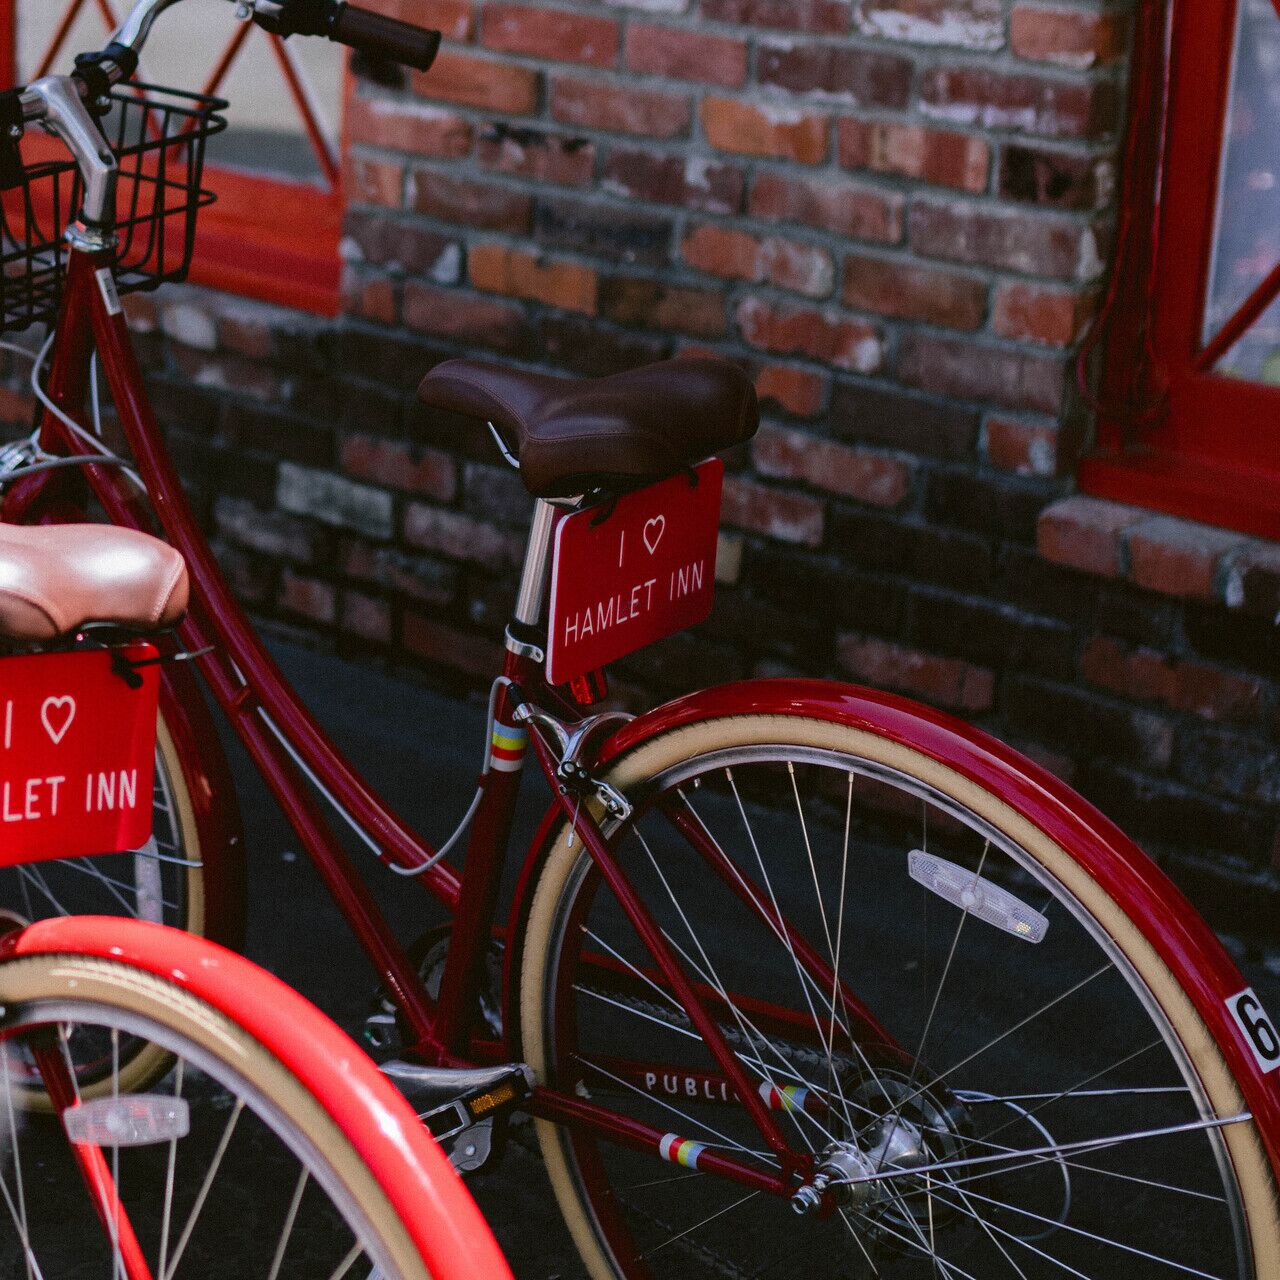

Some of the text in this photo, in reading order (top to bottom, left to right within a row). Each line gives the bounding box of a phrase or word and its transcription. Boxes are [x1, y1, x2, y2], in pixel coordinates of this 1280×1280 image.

[619, 530, 625, 568] I
[564, 559, 704, 647] HAMLET INN
[4, 699, 14, 750] I
[85, 768, 138, 813] INN
[1235, 994, 1280, 1062] 6
[645, 1072, 741, 1103] PUBLI
